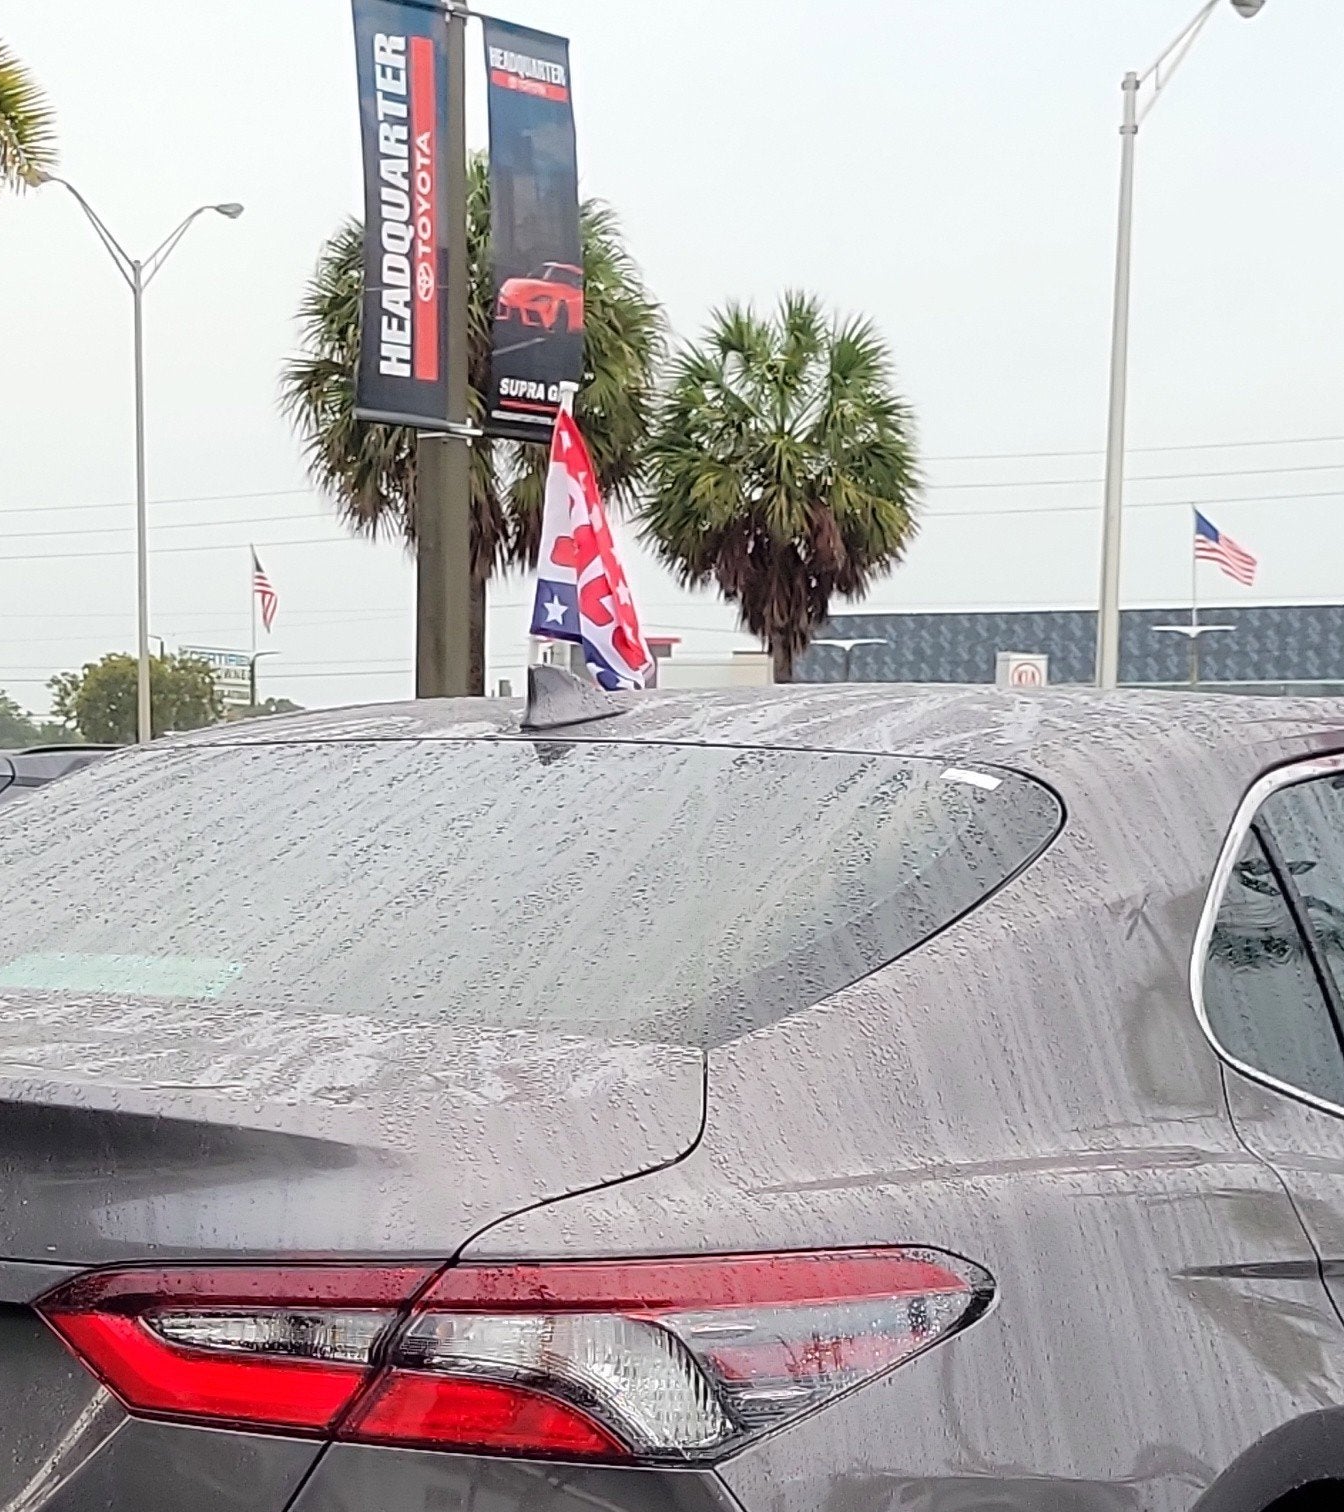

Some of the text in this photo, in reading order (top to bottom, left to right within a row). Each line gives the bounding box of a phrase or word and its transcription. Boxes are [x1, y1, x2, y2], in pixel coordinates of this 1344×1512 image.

[488, 45, 566, 87] HEADQUARTER
[373, 33, 414, 377] HEADQUARTER
[414, 131, 433, 254] TOYOTA
[499, 377, 563, 403] SUPRA G
